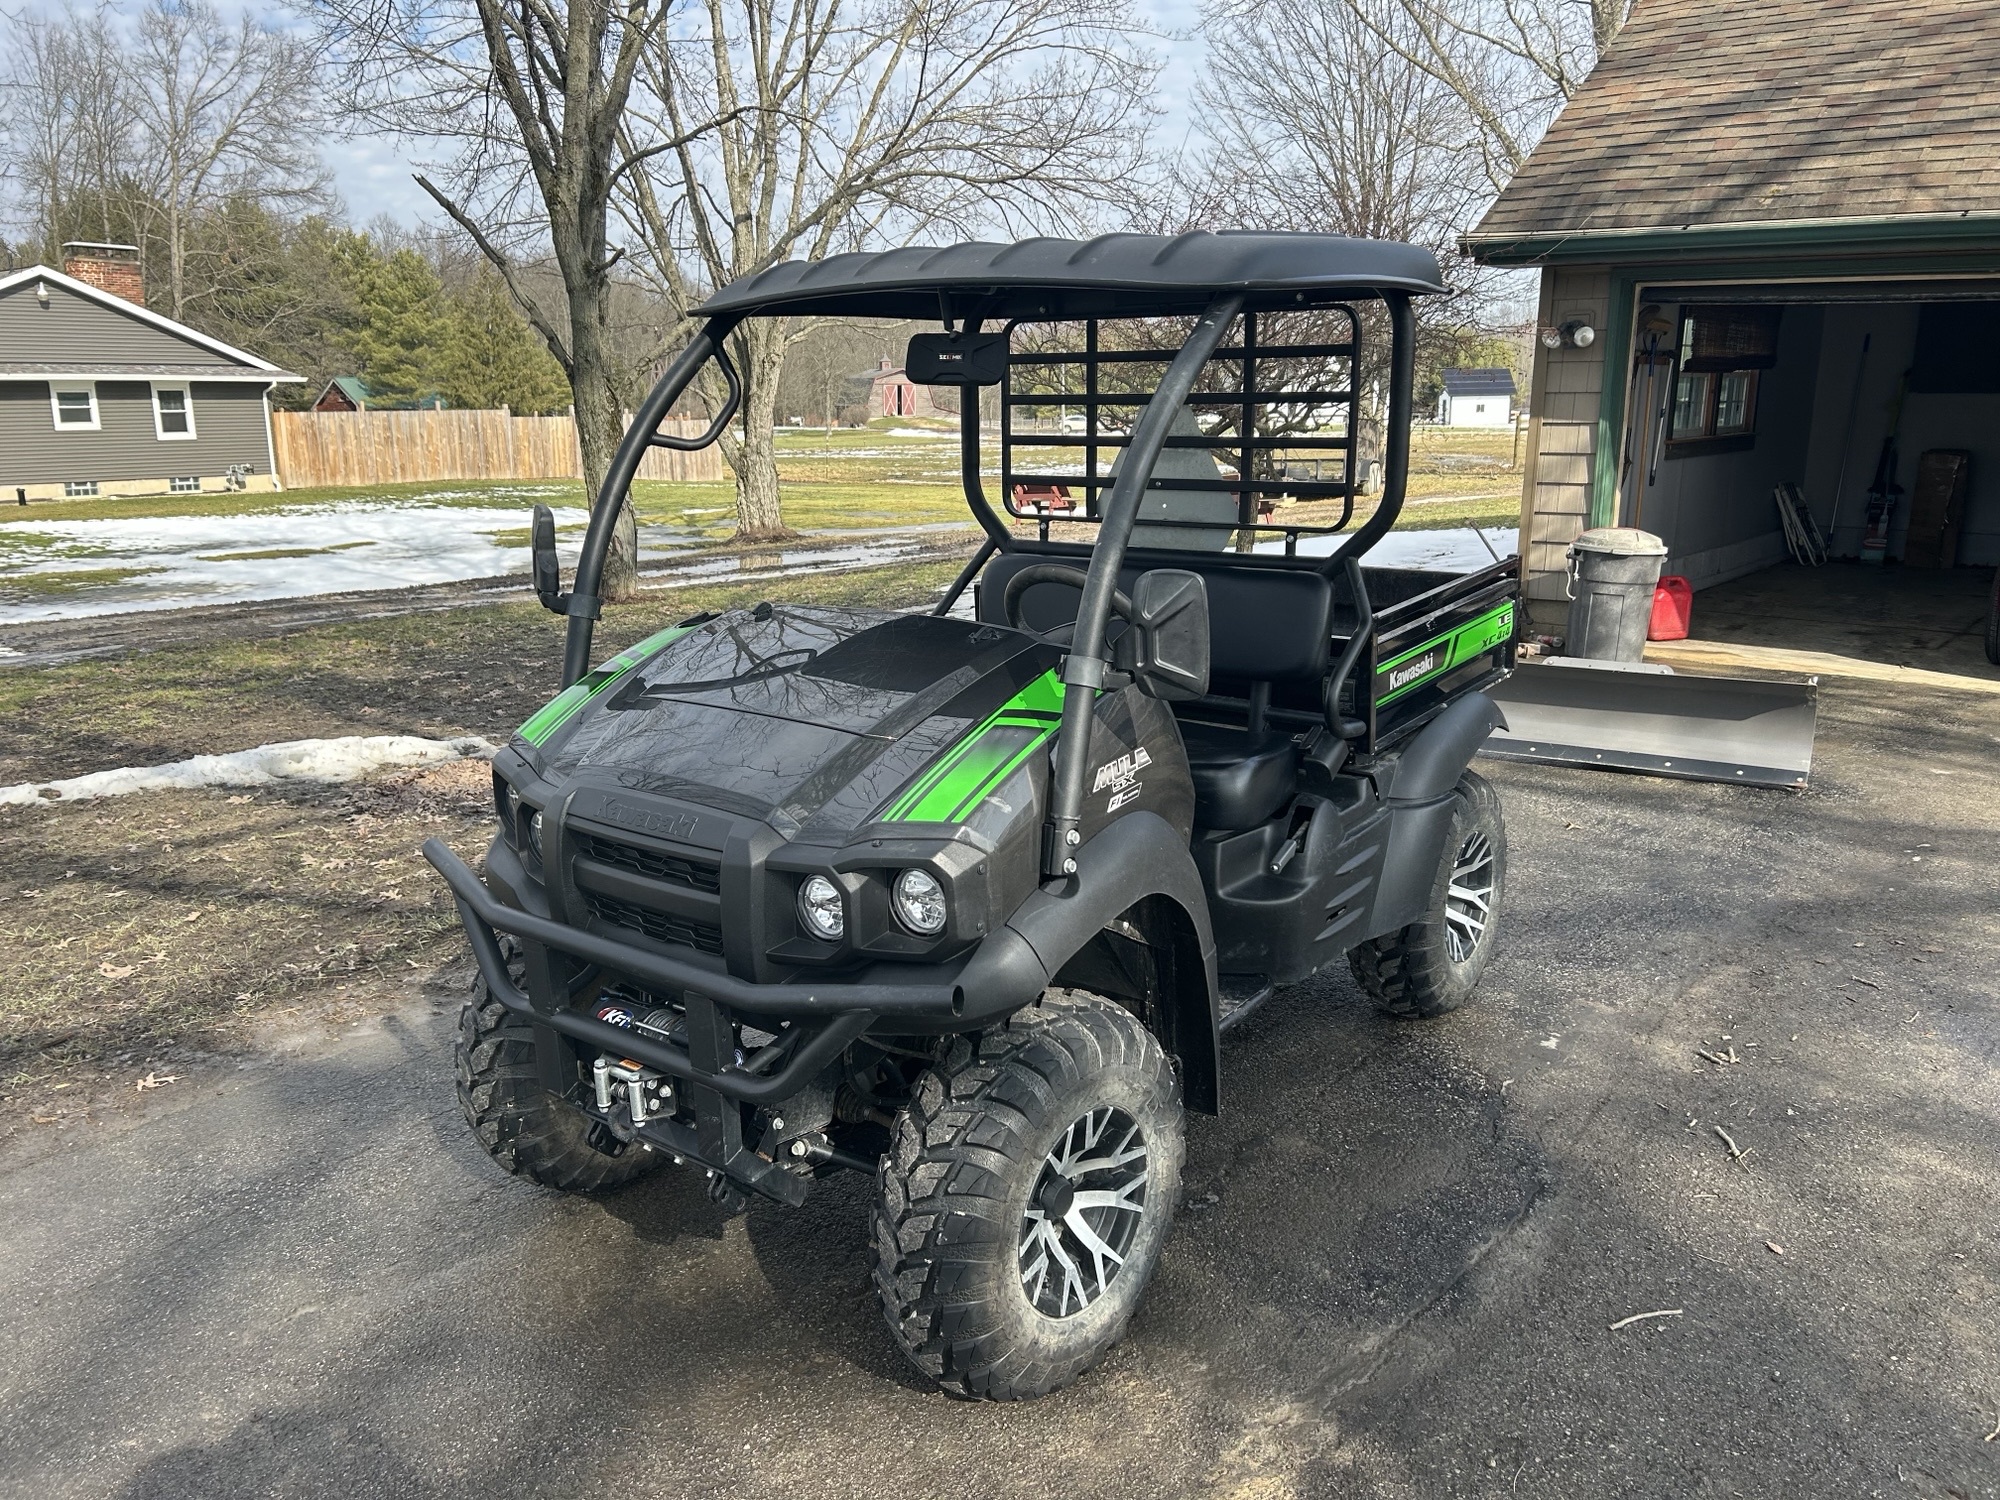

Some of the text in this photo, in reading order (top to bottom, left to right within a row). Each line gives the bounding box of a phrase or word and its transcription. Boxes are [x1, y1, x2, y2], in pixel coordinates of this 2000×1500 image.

[1498, 613, 1512, 627] LE
[1481, 633, 1497, 649] XC
[1389, 652, 1434, 691] Kawasaki
[1092, 746, 1153, 793] MULE
[1112, 771, 1136, 793] SX
[594, 795, 699, 839] Kawasaki
